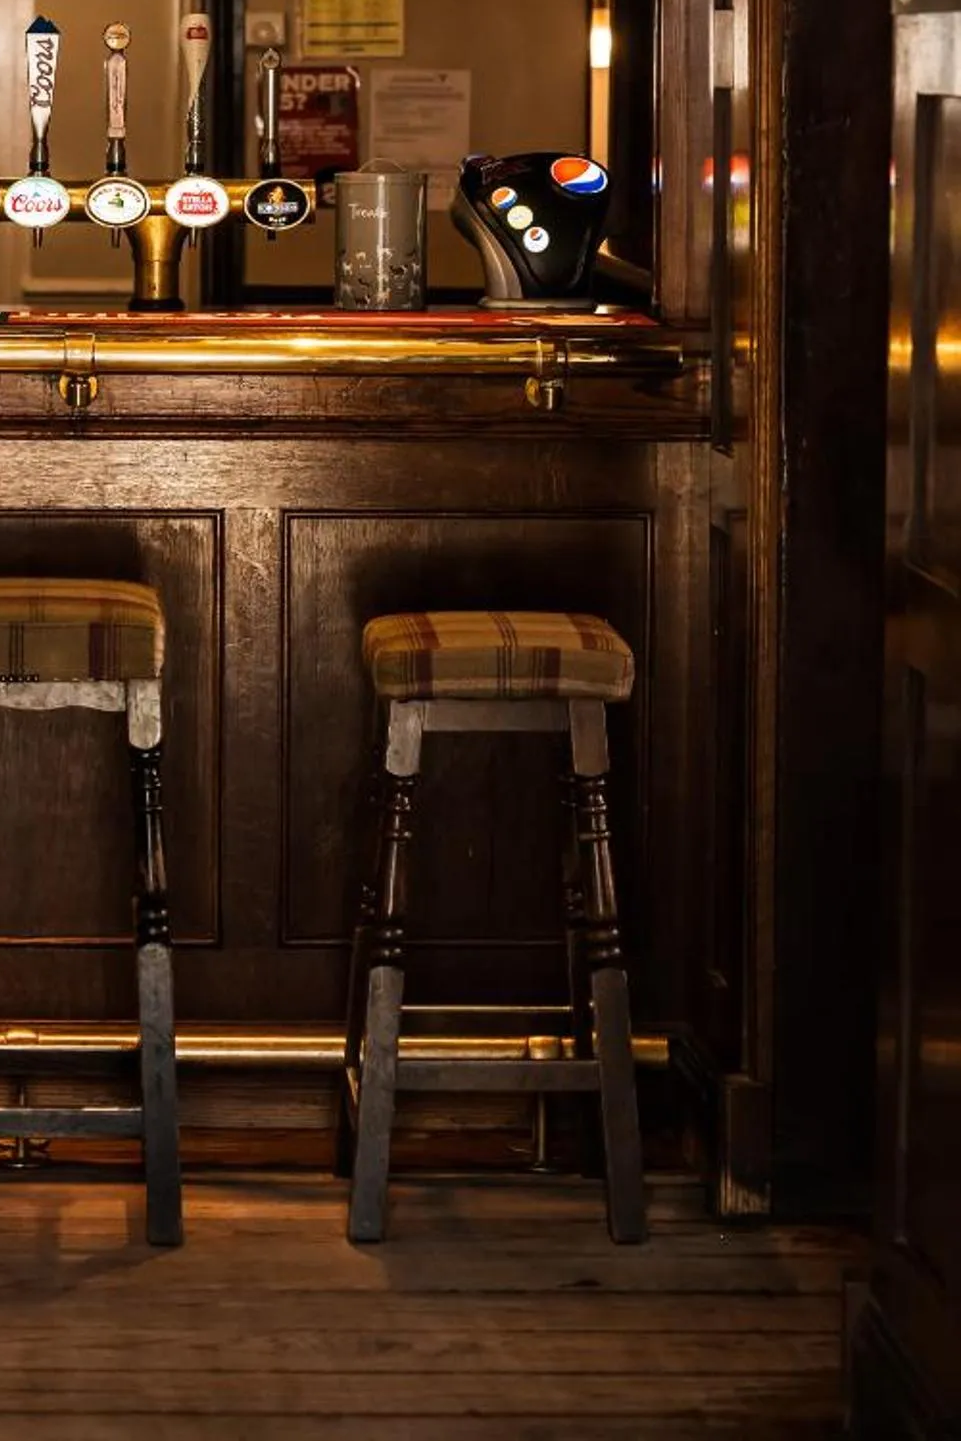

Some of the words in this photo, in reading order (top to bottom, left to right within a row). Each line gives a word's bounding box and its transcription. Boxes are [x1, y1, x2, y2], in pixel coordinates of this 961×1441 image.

[29, 37, 55, 108] Coors
[280, 73, 351, 93] NDER
[279, 93, 308, 111] 5?
[11, 193, 64, 214] Coors
